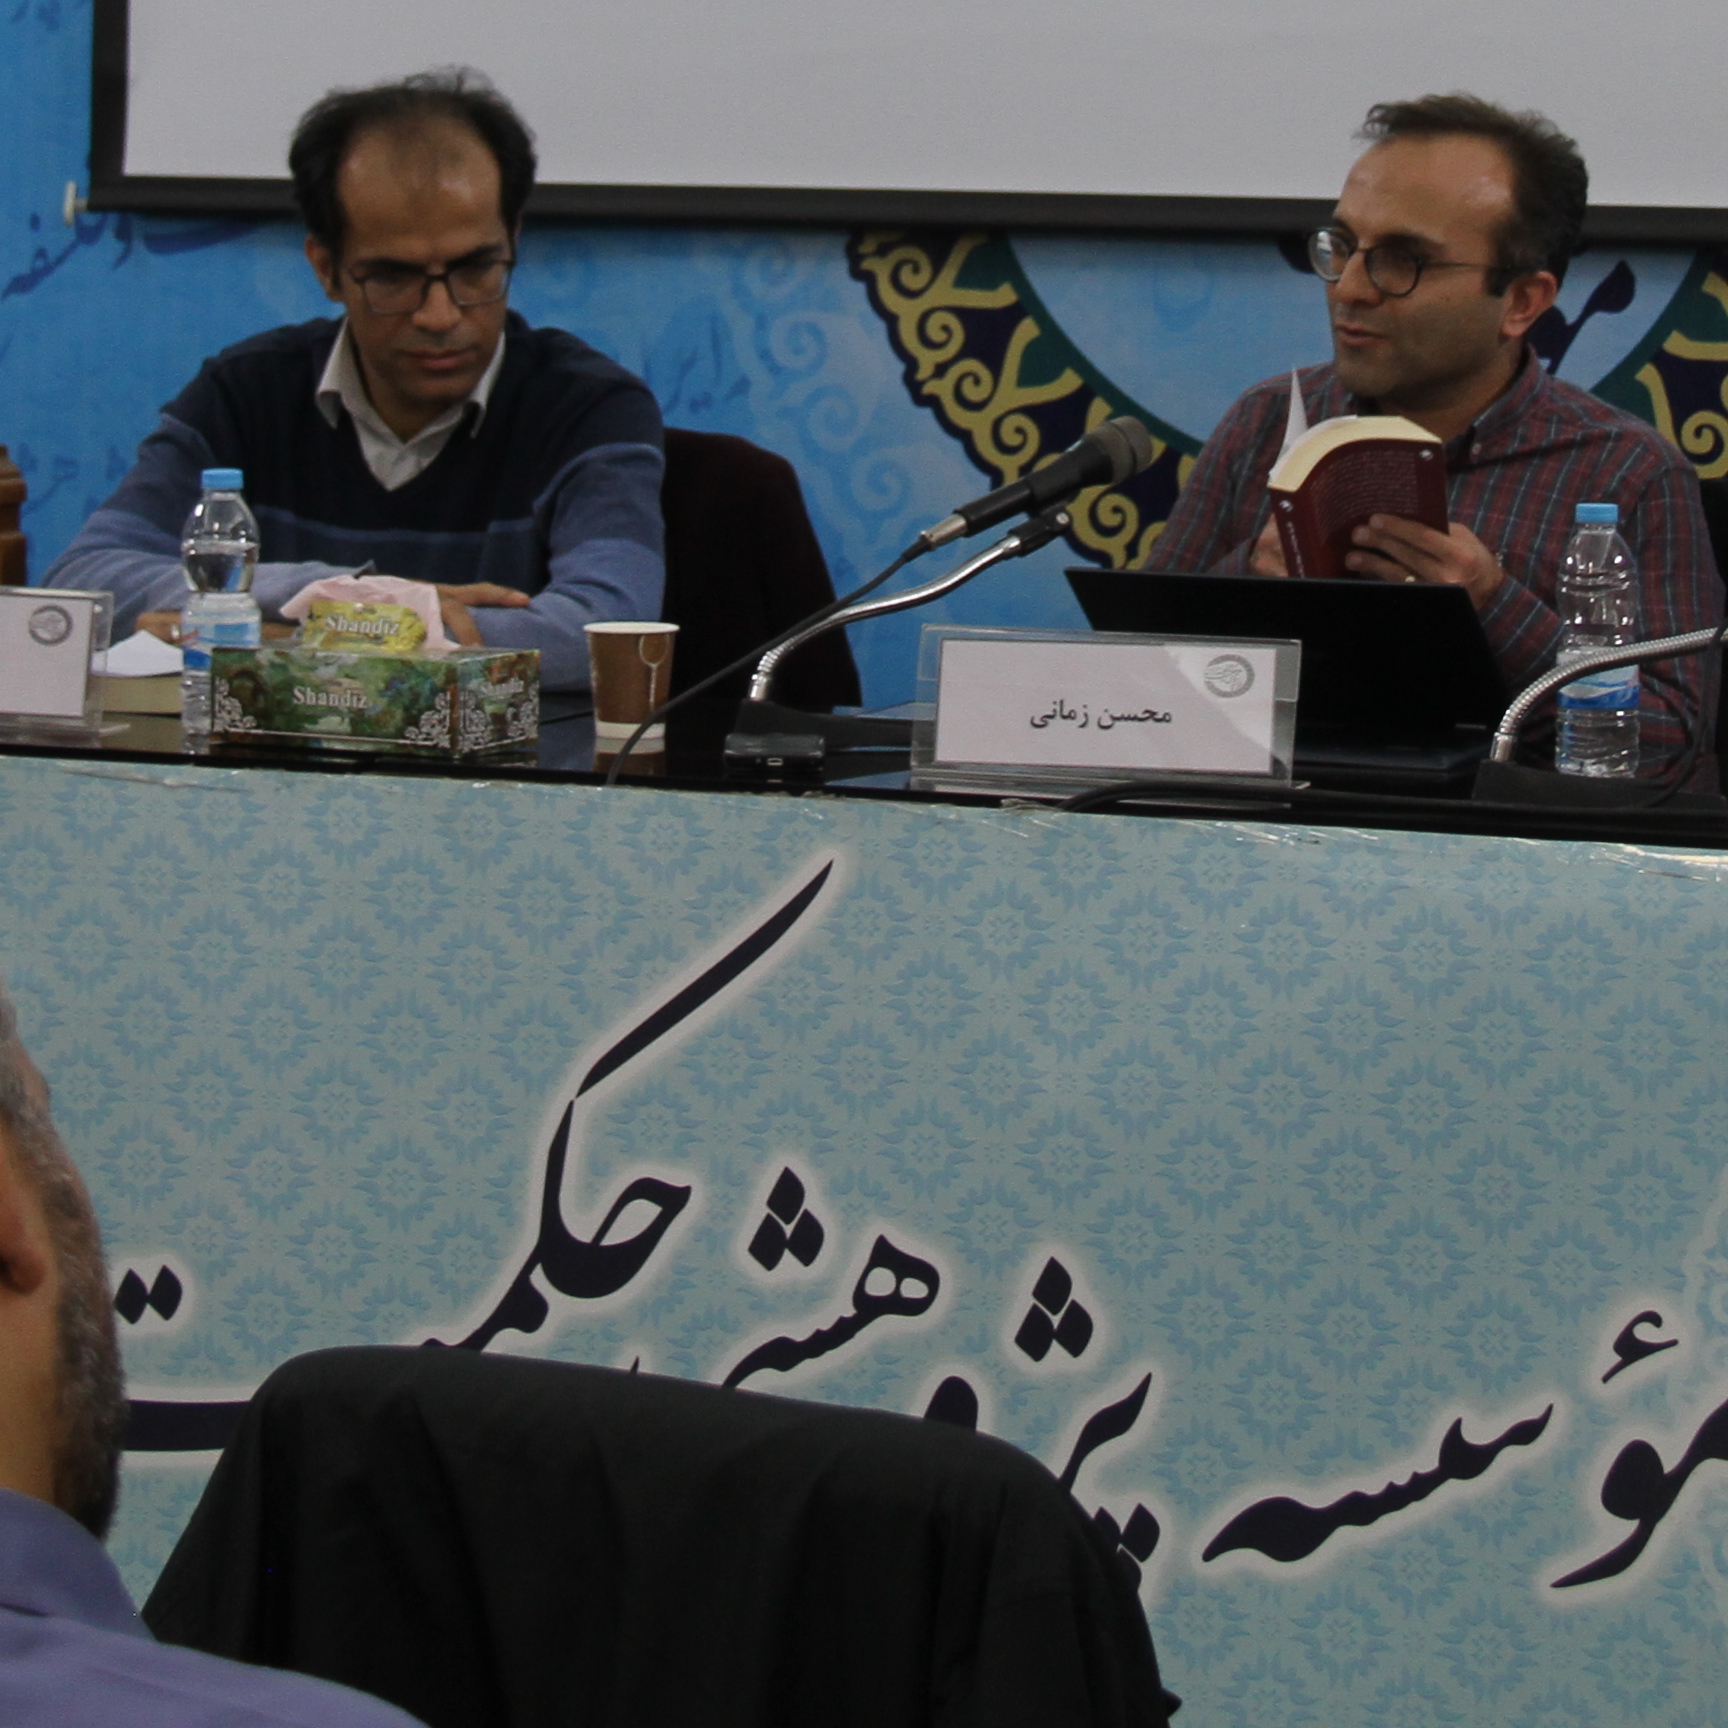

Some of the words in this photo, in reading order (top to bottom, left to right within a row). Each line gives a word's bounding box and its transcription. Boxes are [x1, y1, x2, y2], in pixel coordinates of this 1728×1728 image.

[325, 613, 401, 637] Shandiz
[292, 685, 369, 709] Shandiz
[1029, 698, 1091, 730] زمانی
[1096, 704, 1173, 731] محسن
